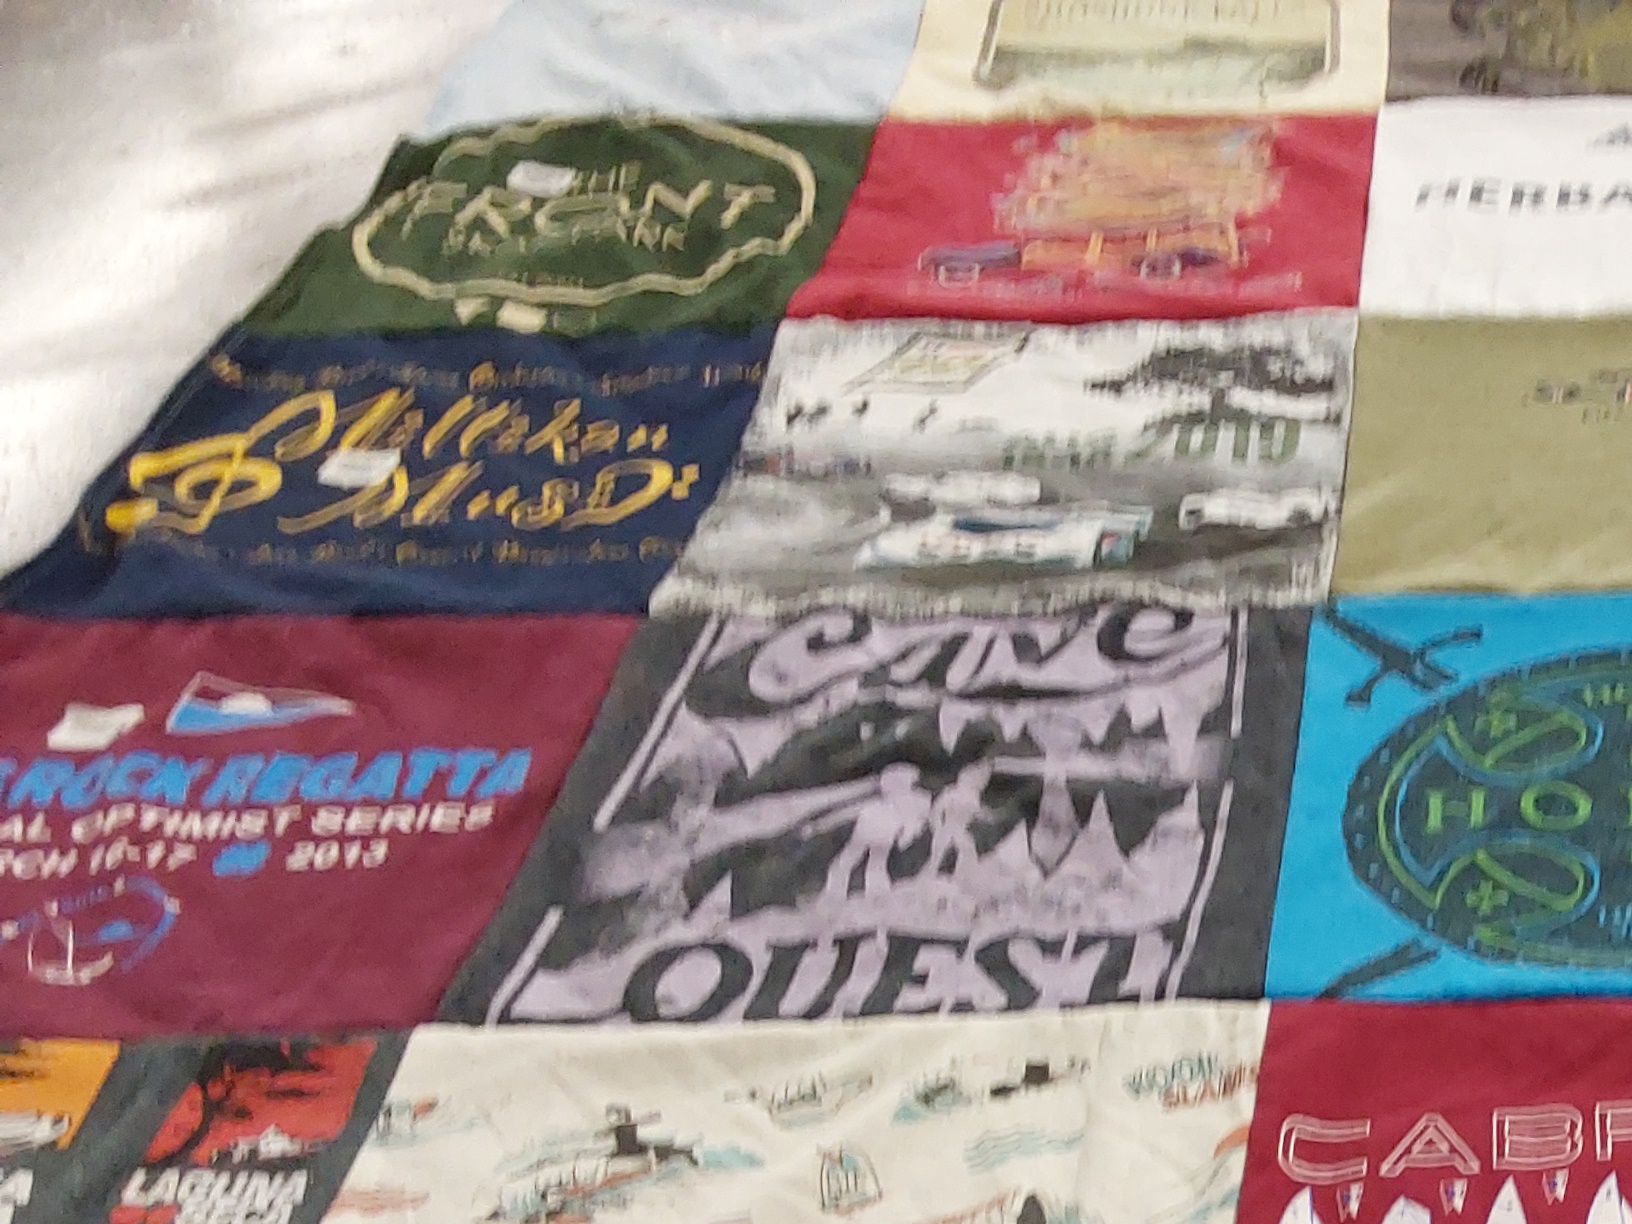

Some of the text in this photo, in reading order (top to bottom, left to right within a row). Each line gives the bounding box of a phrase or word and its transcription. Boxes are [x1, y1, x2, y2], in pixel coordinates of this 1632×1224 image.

[203, 747, 532, 808] REGATTA
[310, 802, 495, 836] SERIES
[284, 837, 389, 873] 2013
